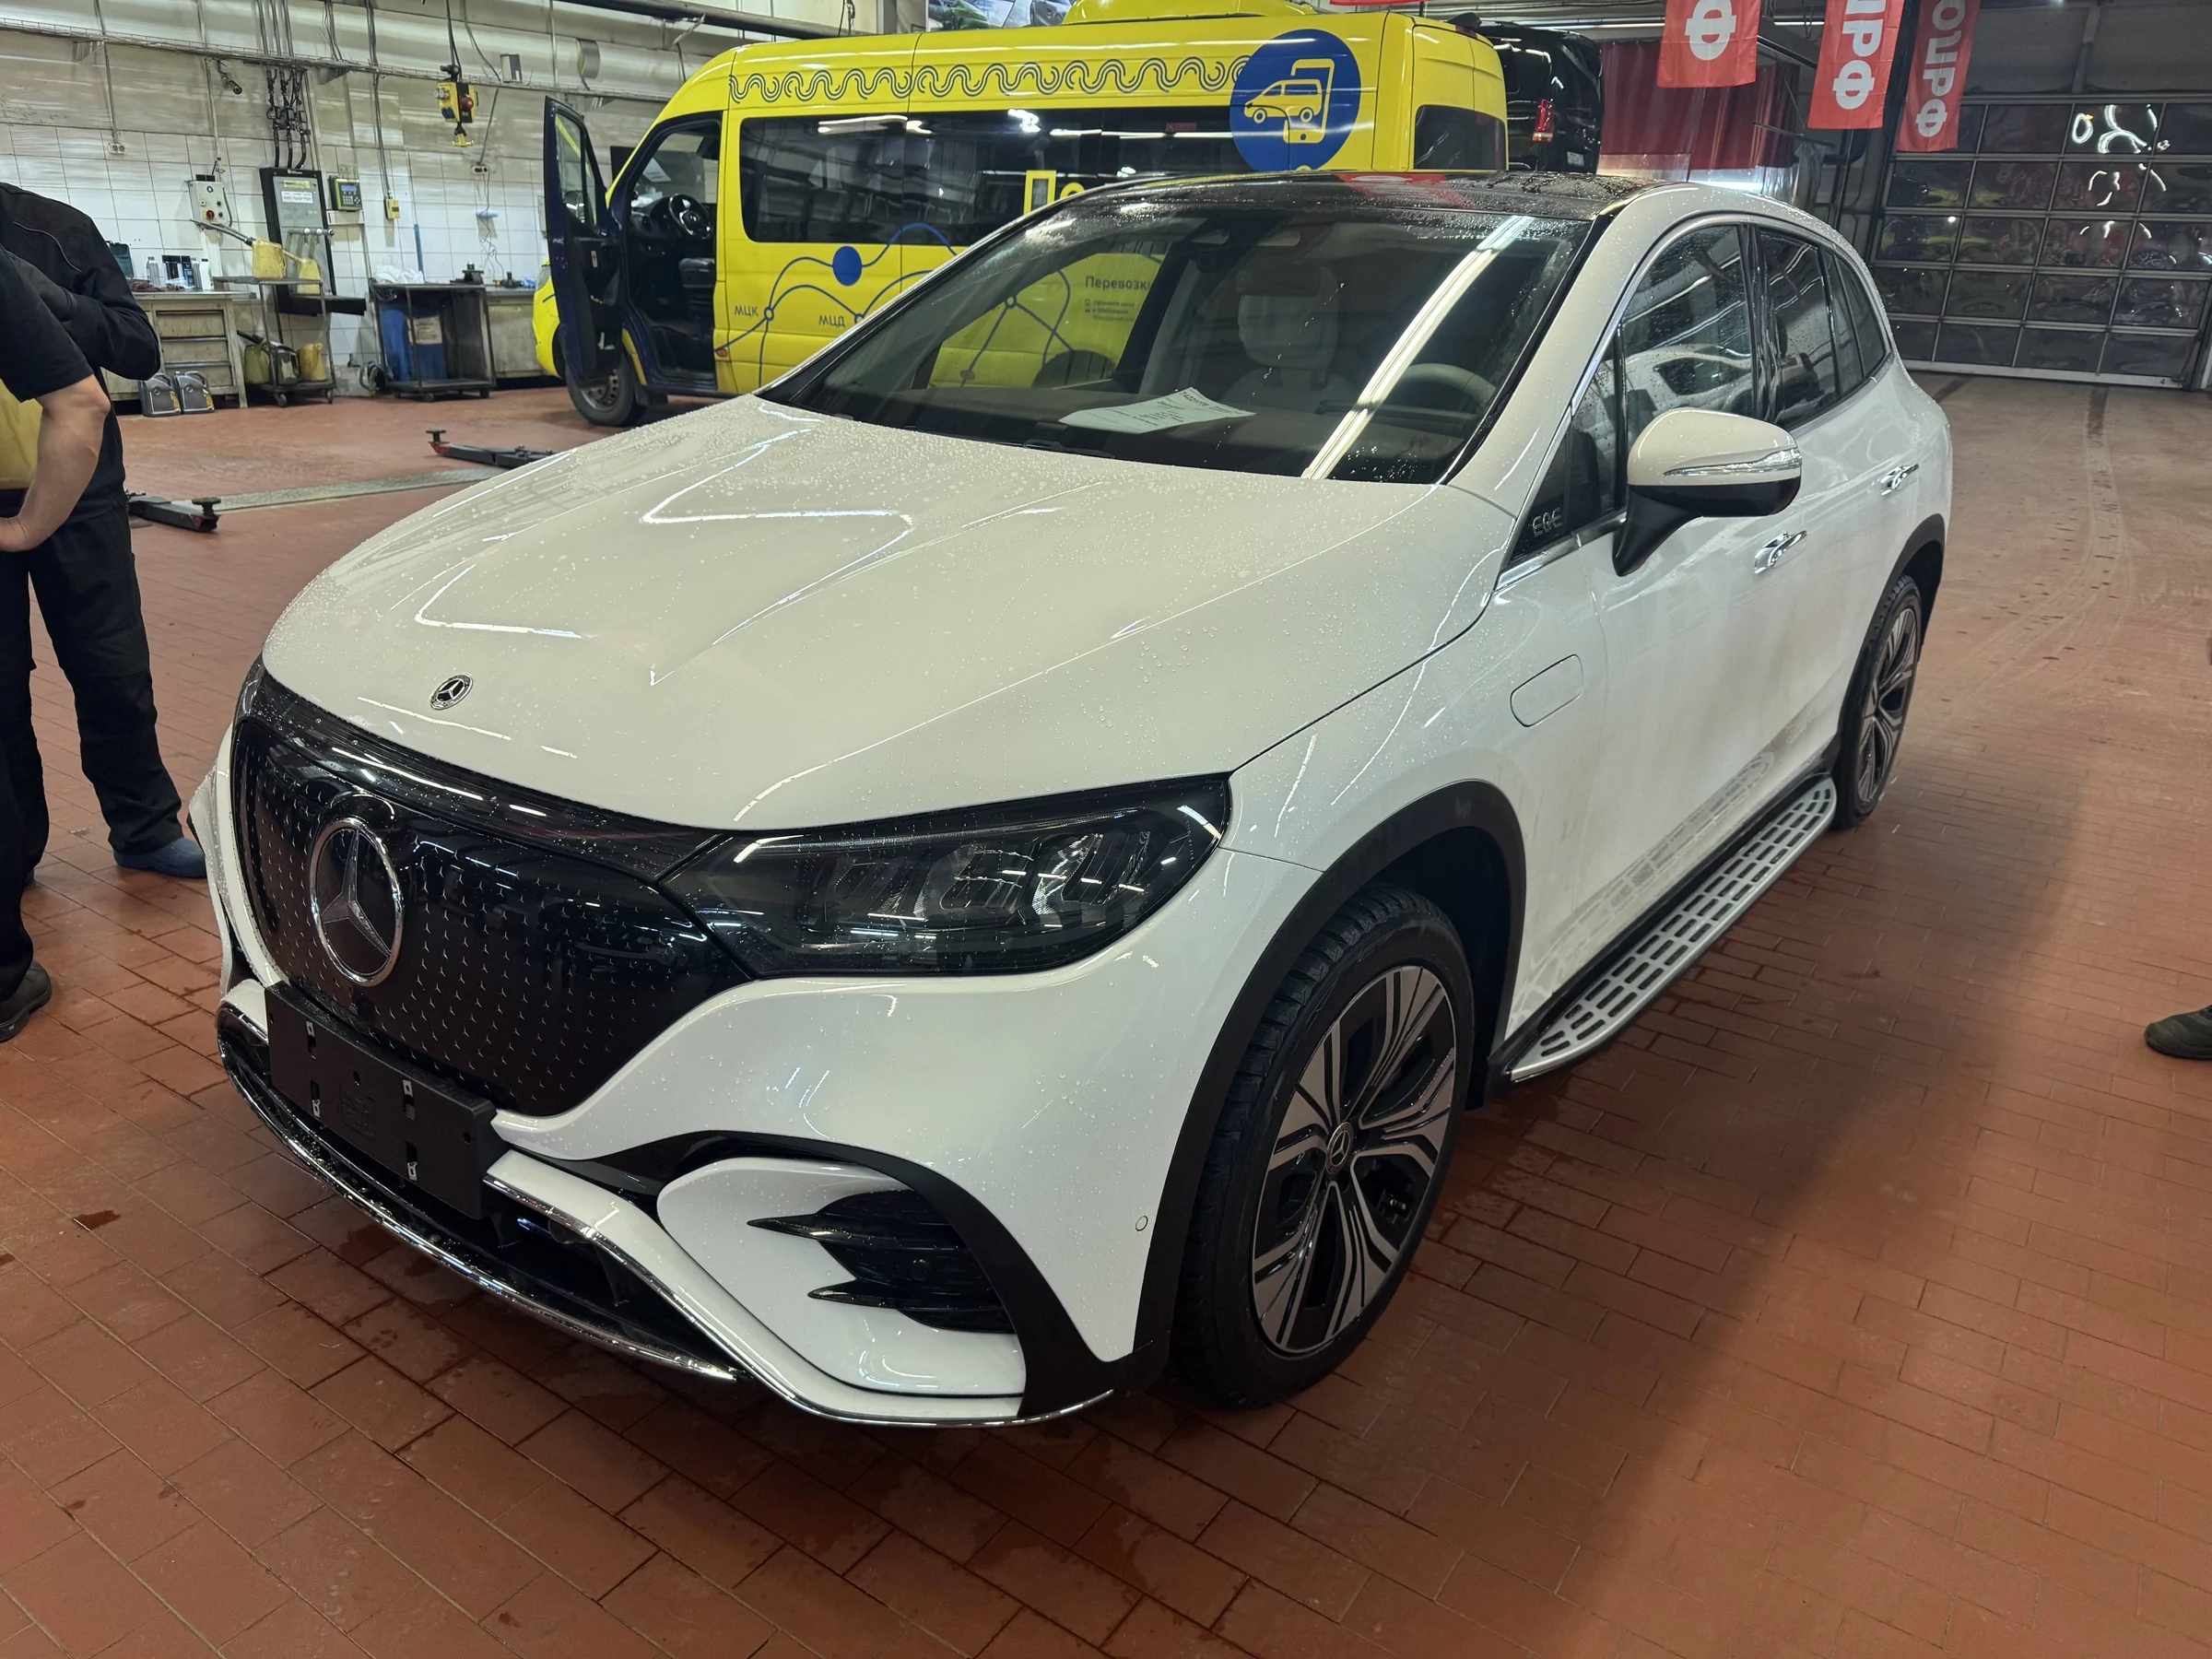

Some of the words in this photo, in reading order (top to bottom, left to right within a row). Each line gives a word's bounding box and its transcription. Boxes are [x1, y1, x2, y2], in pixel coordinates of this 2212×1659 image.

[734, 305, 759, 317] МЦК
[818, 314, 846, 328] МЦД
[1532, 507, 1563, 536] EQE
